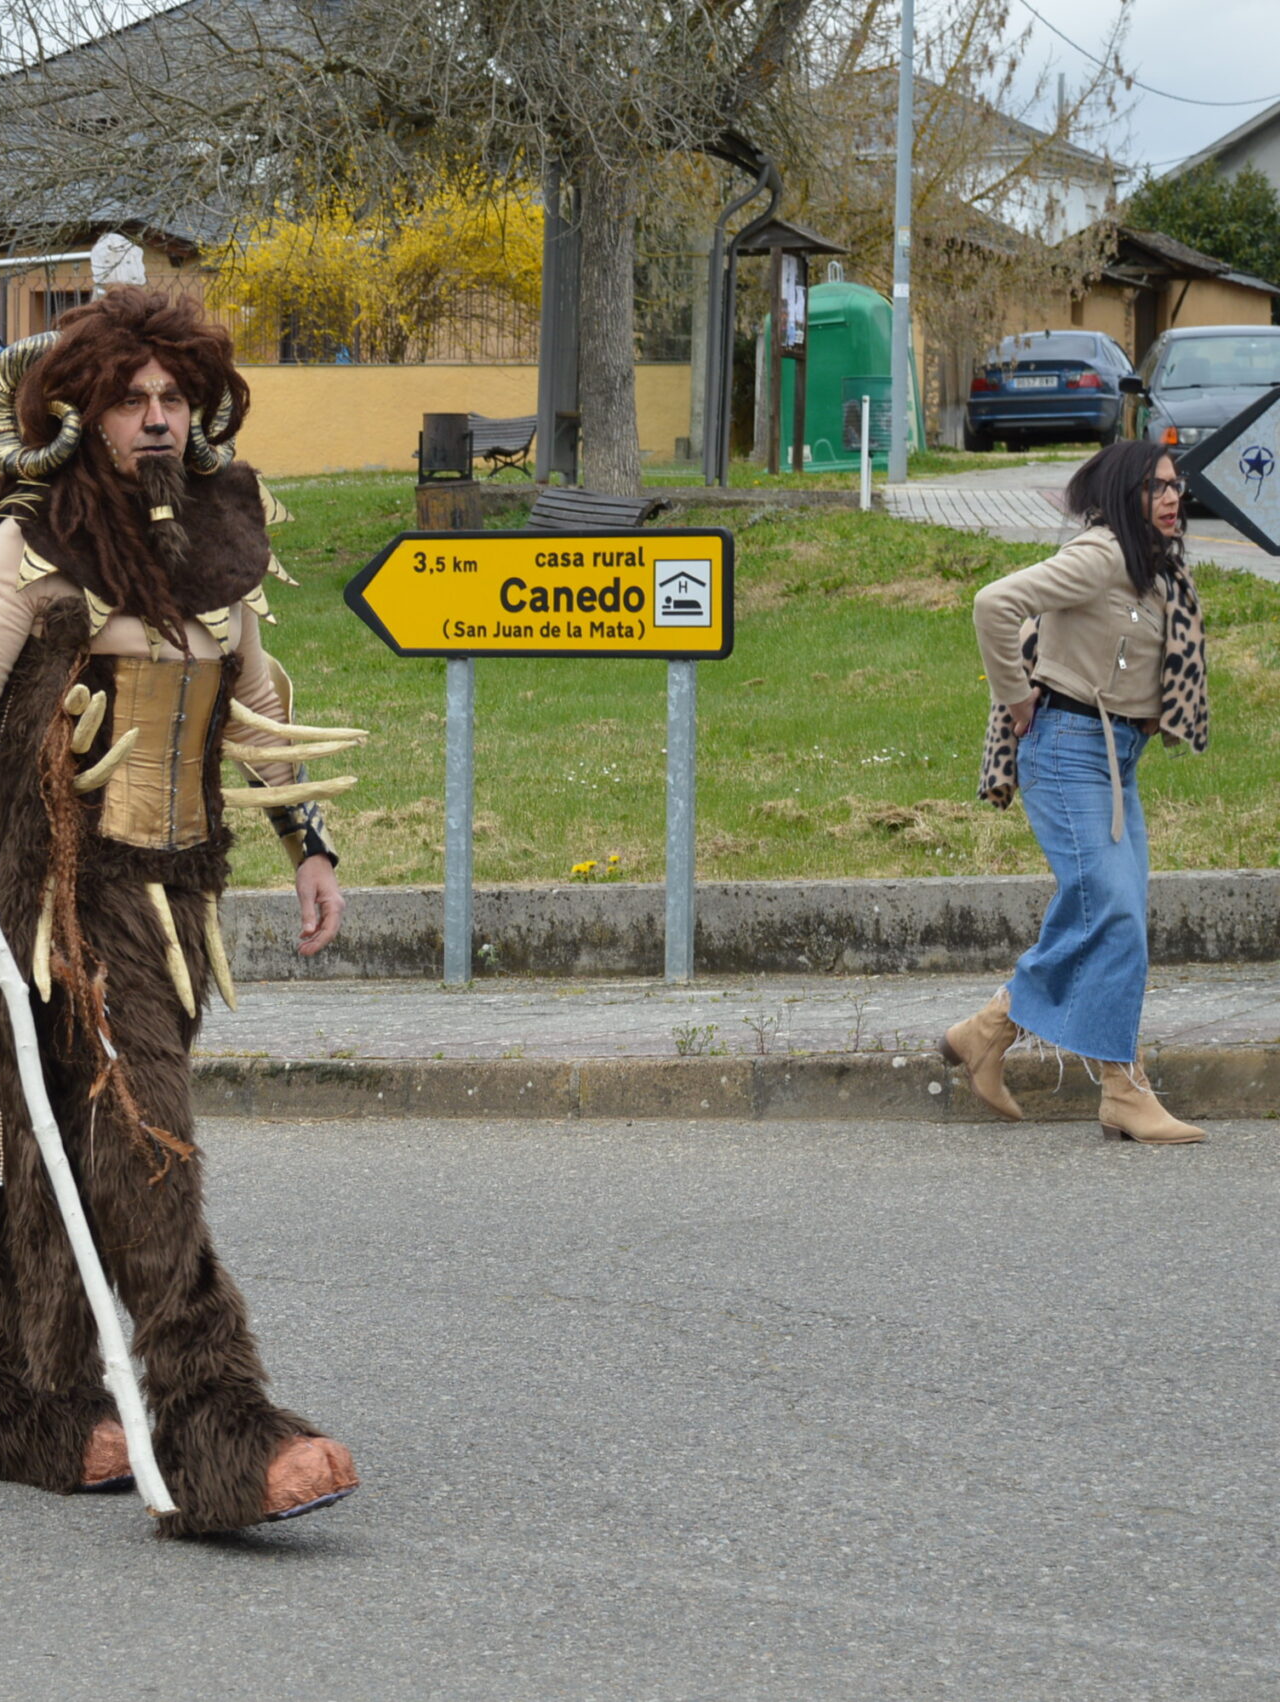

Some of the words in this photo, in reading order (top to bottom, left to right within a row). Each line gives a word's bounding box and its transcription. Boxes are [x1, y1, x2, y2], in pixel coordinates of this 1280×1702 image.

[414, 552, 445, 574] 3,5
[453, 557, 477, 572] km
[535, 552, 584, 567] casa
[593, 546, 645, 567] rural
[500, 577, 645, 613] Canedo
[678, 580, 688, 594] H
[443, 619, 486, 639] (San
[493, 621, 533, 637] Juan
[540, 621, 560, 638] de
[567, 622, 582, 638] la
[590, 619, 645, 640] Mata)
